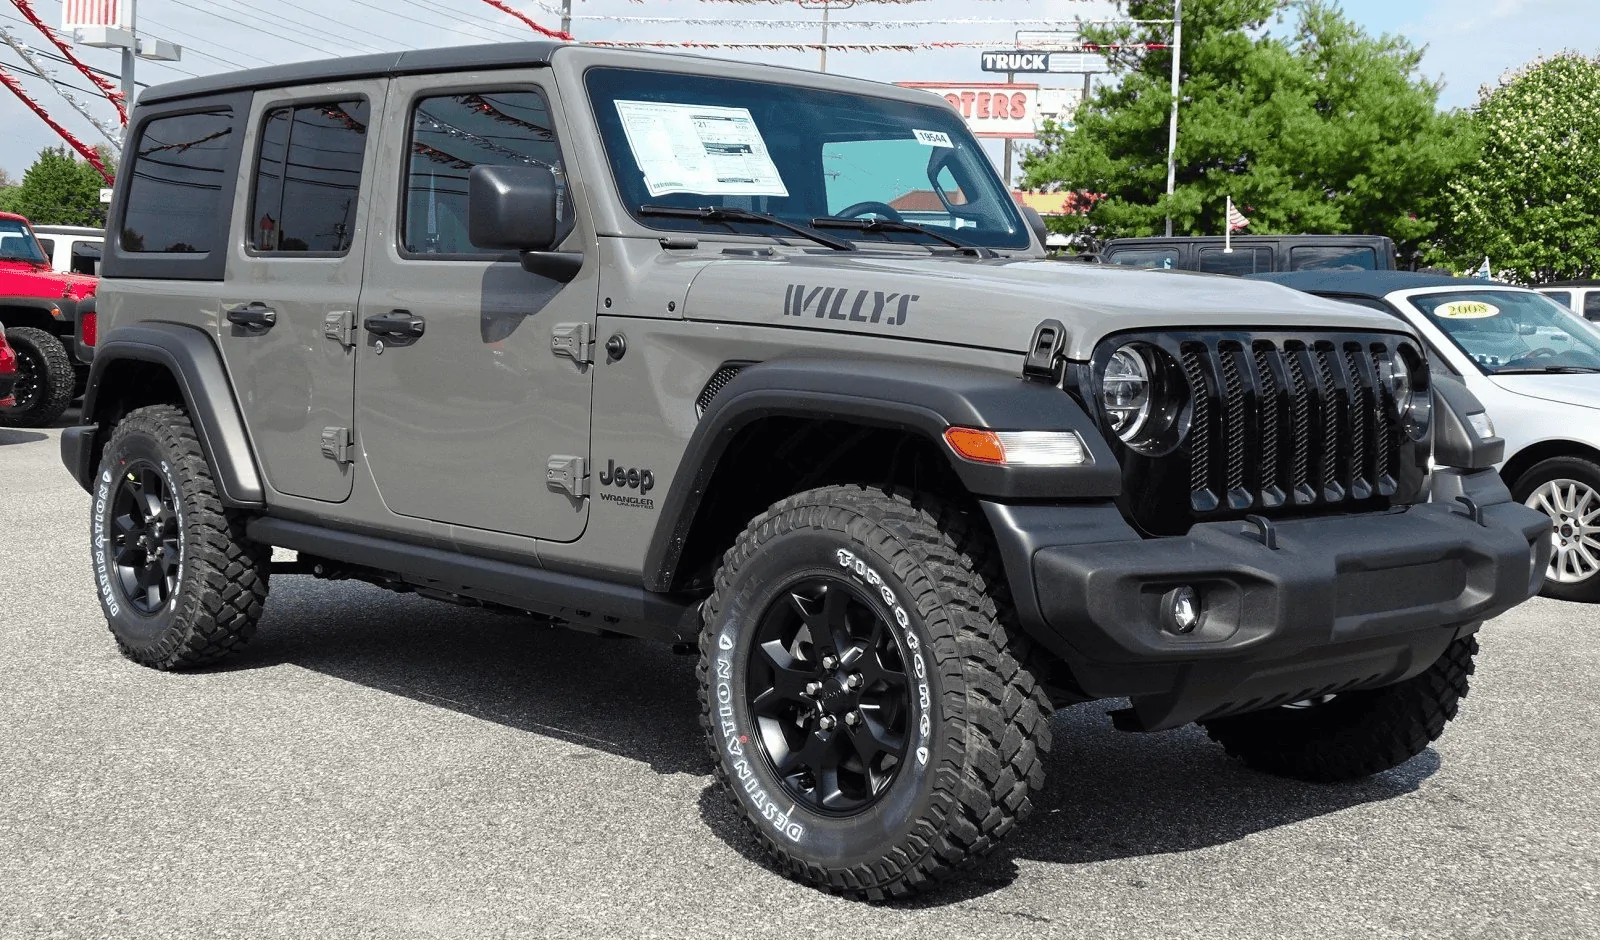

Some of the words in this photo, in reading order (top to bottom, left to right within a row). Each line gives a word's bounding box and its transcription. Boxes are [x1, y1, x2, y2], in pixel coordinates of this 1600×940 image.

[983, 54, 1047, 70] TRUCK
[919, 132, 947, 143] 19544
[783, 284, 920, 326] WILLYS
[1448, 304, 1488, 316] 2008
[599, 459, 655, 496] Jeep
[600, 492, 654, 506] WRANGLER
[617, 501, 654, 510] UNLIMITED
[95, 485, 120, 617] DESTINATION
[717, 659, 804, 843] DESTINATION
